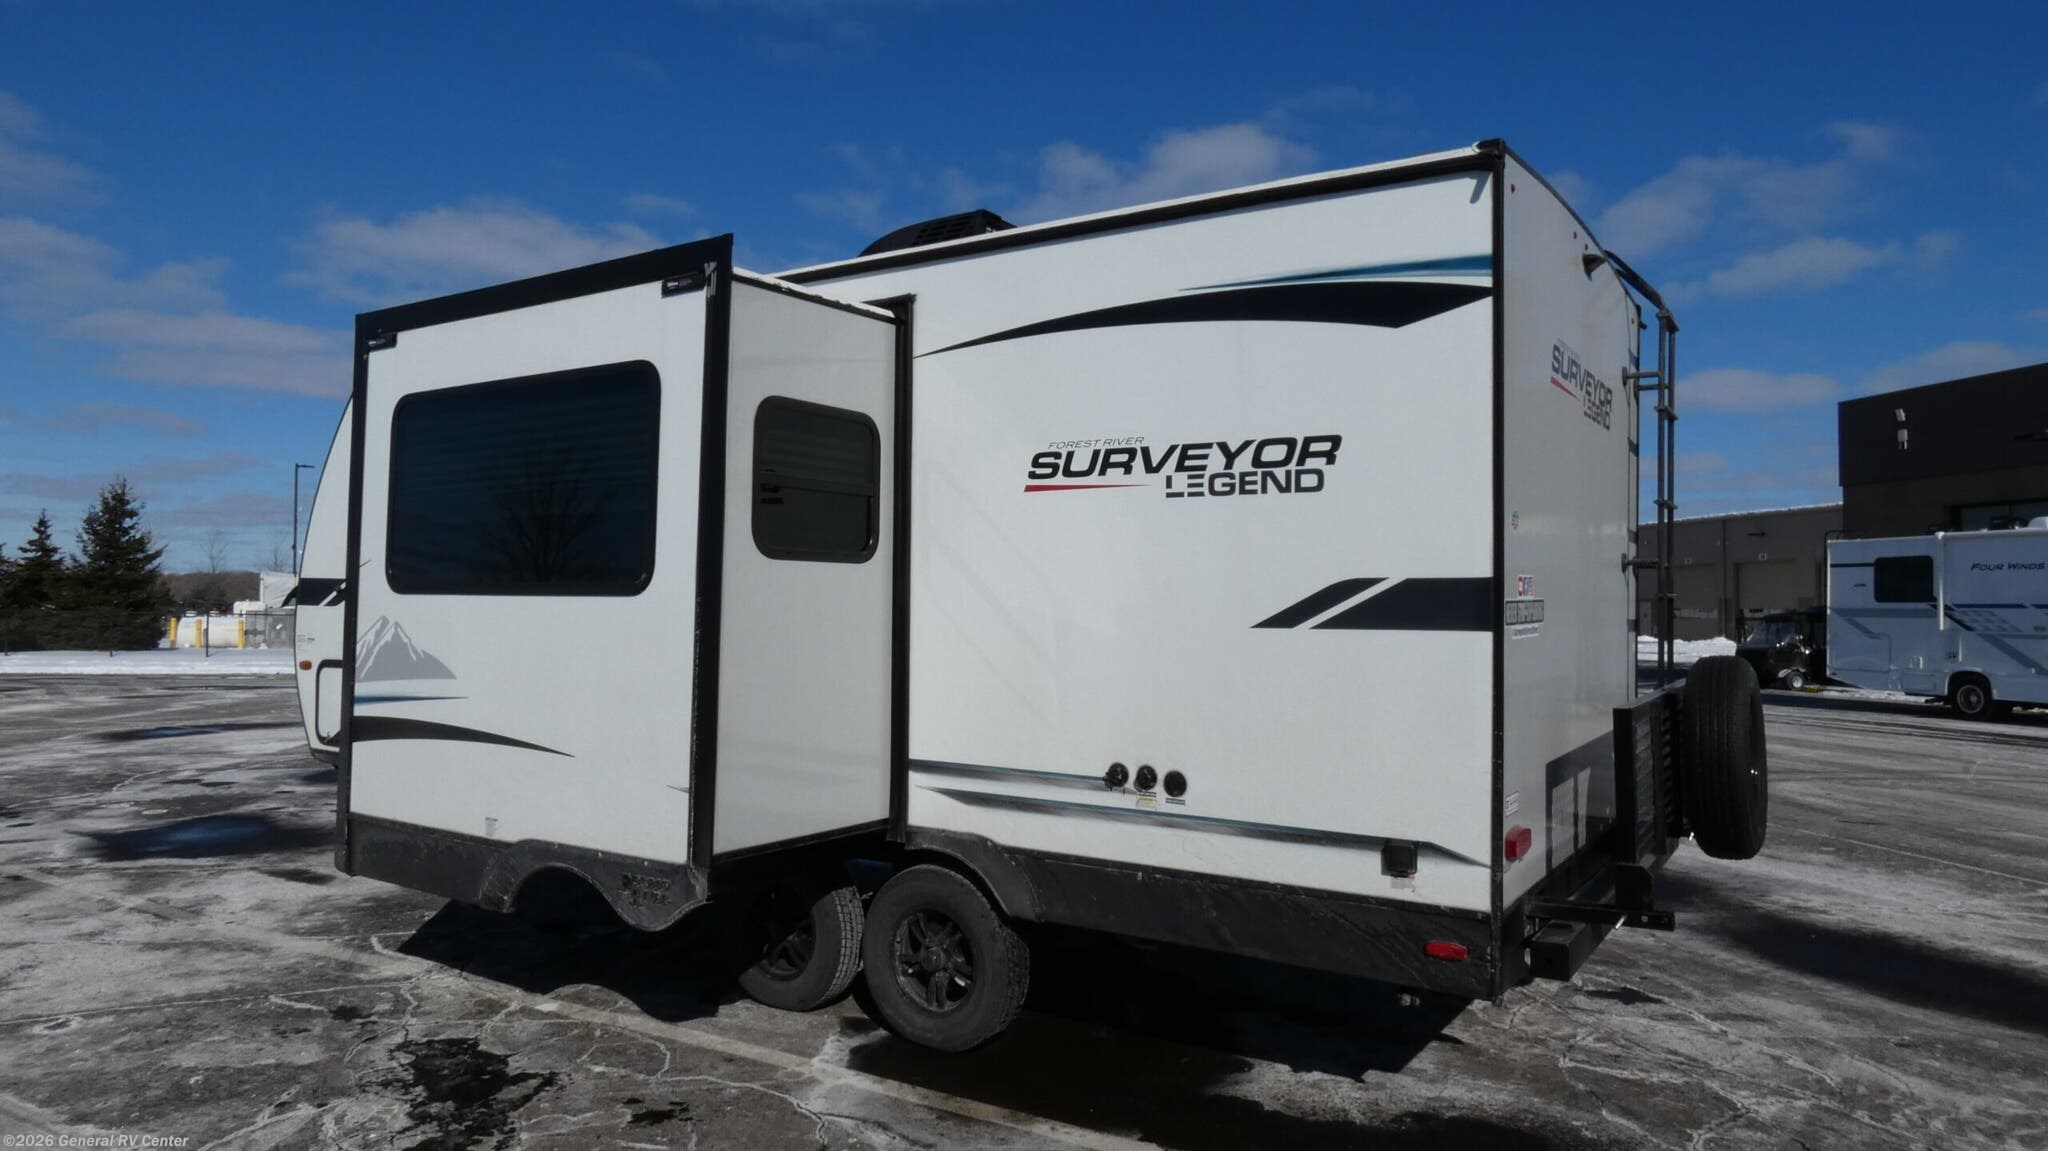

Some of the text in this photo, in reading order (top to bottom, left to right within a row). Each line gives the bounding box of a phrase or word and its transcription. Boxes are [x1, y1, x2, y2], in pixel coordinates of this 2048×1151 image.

[1552, 344, 1613, 413] SURVEYOR
[1583, 395, 1611, 431] LEGEND
[1028, 434, 1343, 480] SURVEYOR
[1048, 436, 1145, 450] FOREST RIVER
[1165, 468, 1325, 498] LEGEND
[1971, 562, 2045, 571] FOUR WINDS
